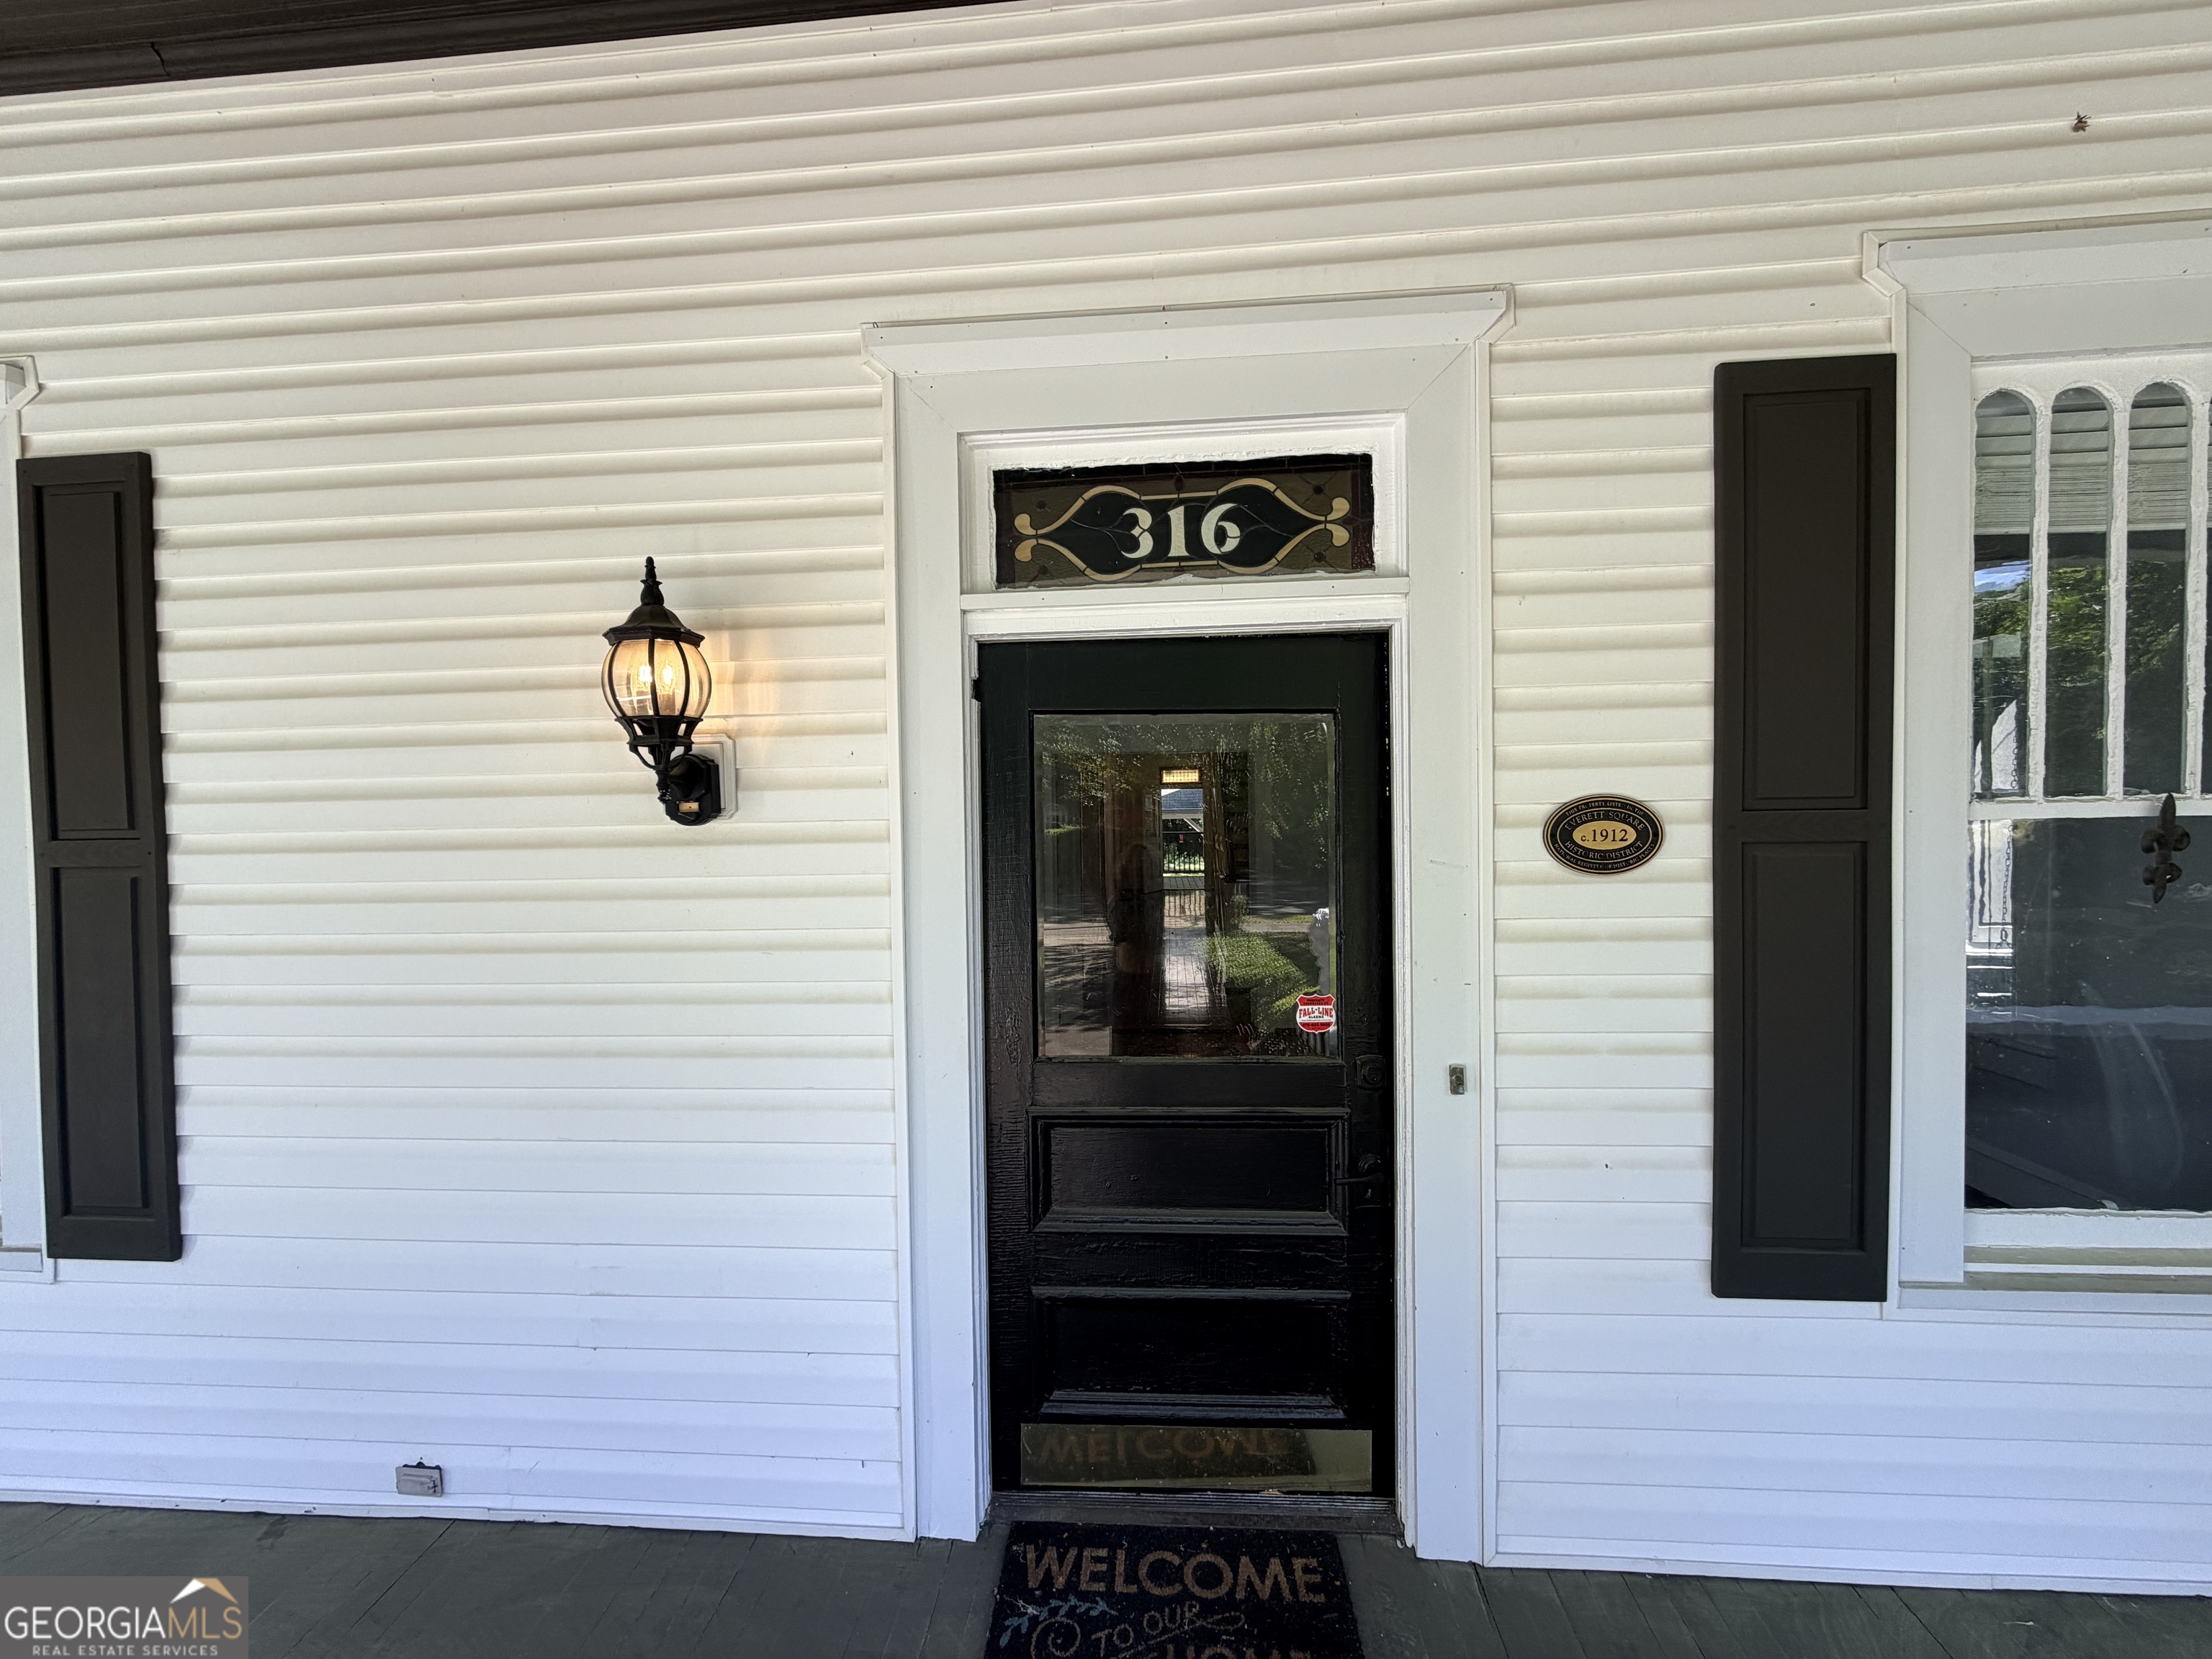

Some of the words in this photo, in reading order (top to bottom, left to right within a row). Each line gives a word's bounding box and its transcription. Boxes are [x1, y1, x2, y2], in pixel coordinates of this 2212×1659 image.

[1120, 503, 1241, 558] 316
[1564, 811, 1605, 831] EVERETT
[1609, 811, 1645, 831] SQUARE
[1565, 807, 1578, 817] THIS
[1581, 829, 1629, 842] c.1912
[1554, 843, 1577, 864] NATIONAL
[1577, 860, 1603, 869] REGISTER
[1613, 857, 1640, 868] HISTORIC
[1640, 843, 1655, 860] PLACES
[1565, 841, 1604, 859] HISTORIC
[1606, 840, 1644, 859] DISTRICT
[1025, 1545, 1326, 1604] WELCOME
[1091, 1623, 1134, 1657] TO
[1143, 1601, 1201, 1634] OUR
